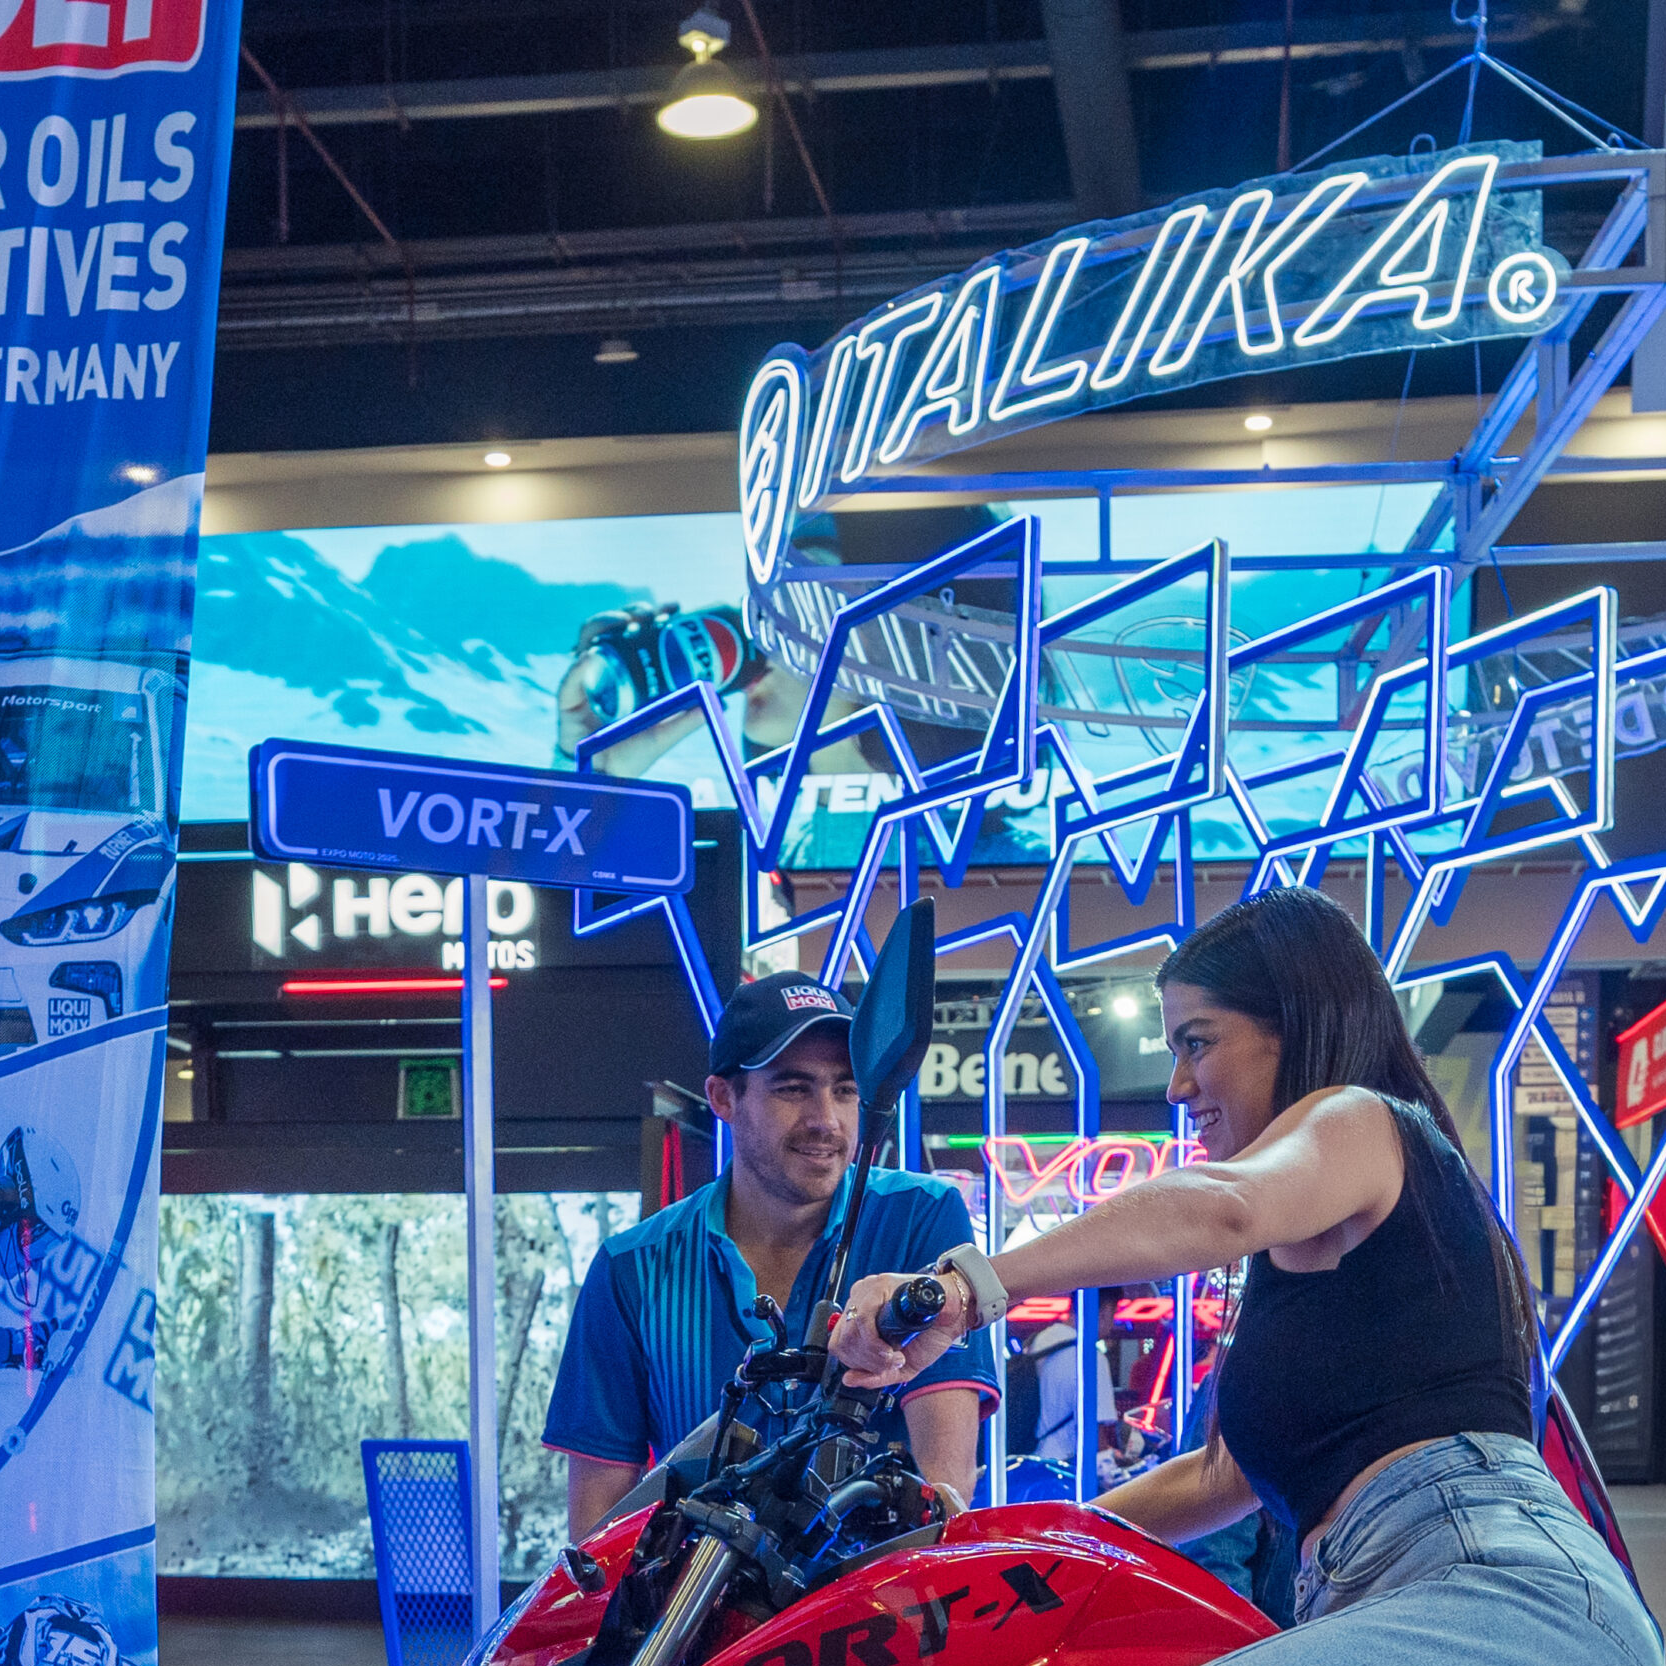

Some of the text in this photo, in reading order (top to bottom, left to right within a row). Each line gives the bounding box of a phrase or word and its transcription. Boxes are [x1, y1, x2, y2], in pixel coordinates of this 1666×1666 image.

[28, 111, 198, 208] OILS
[798, 153, 1499, 508] ITALIKA
[679, 621, 715, 681] PEPS
[2, 695, 102, 713] Motorsport
[378, 788, 592, 855] VORT-X
[442, 940, 535, 970] MTOS
[786, 986, 830, 1000] LIQUI
[789, 997, 833, 1009] MOLY
[49, 998, 90, 1016] LIQUI
[49, 1017, 89, 1036] MOLY
